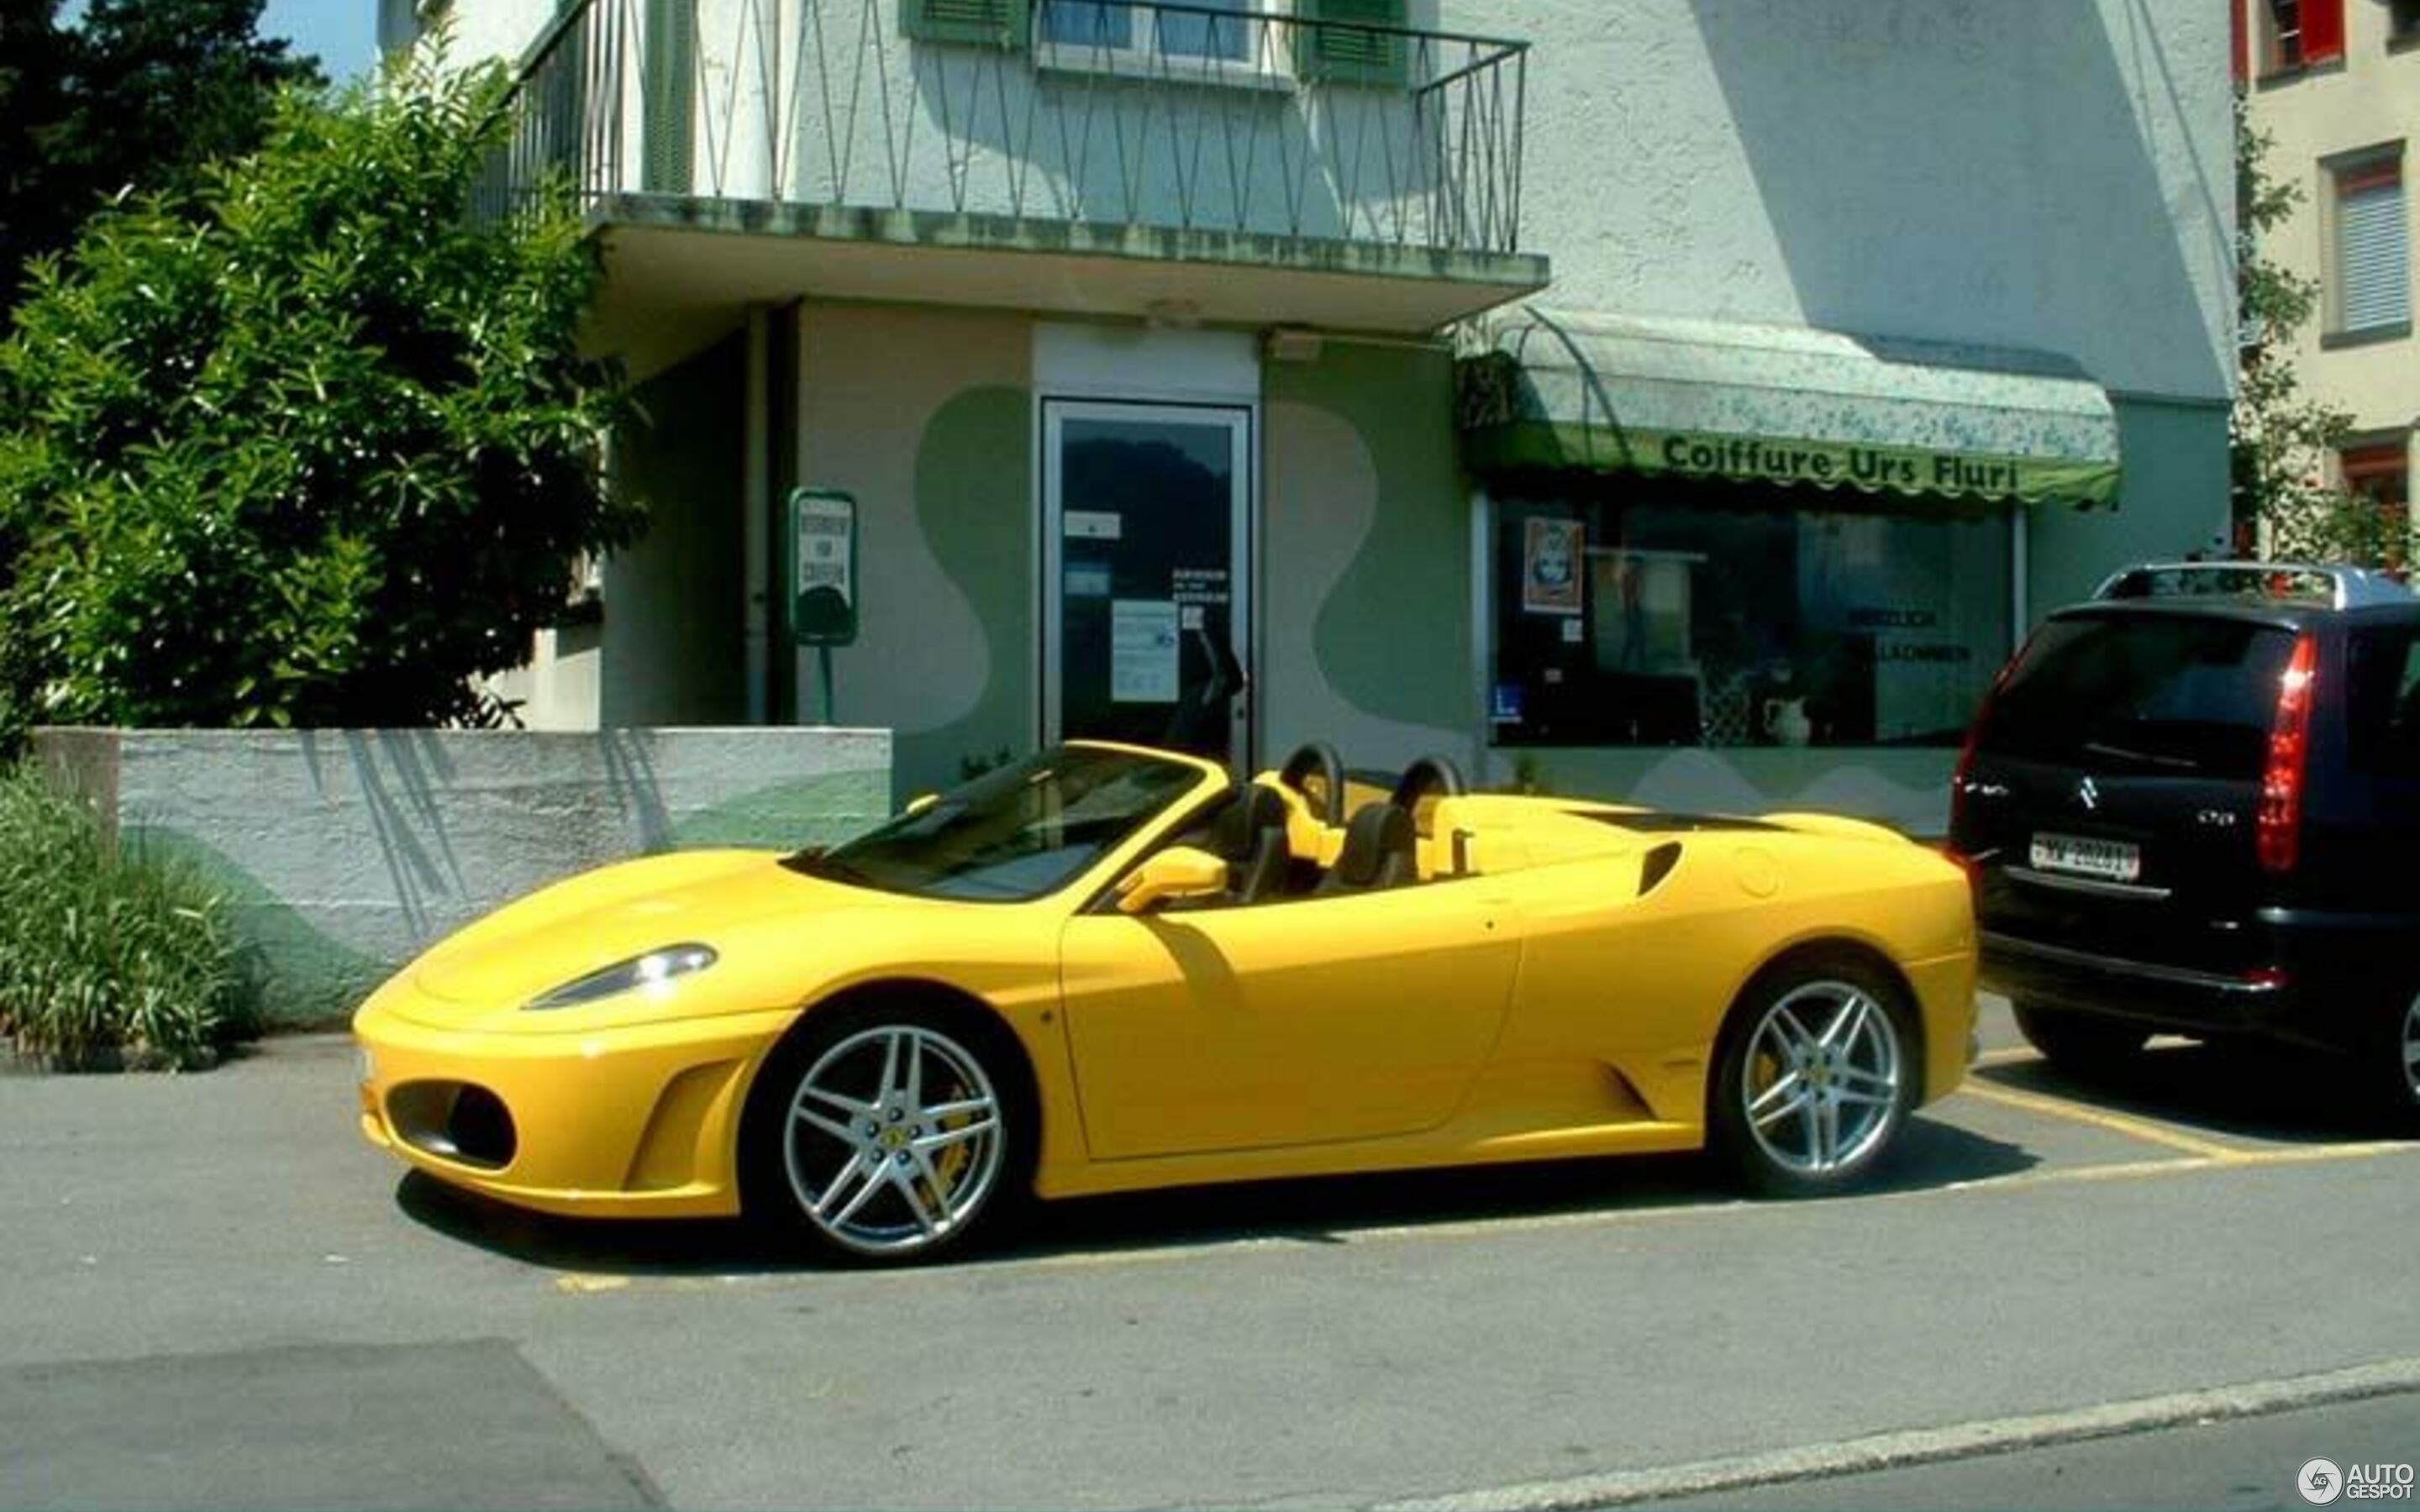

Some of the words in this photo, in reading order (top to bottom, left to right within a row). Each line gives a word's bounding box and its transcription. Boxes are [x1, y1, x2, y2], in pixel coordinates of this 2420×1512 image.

[1663, 435, 1833, 476] Coiffure
[1850, 448, 1915, 481] Urs
[1935, 454, 2017, 487] Fluri
